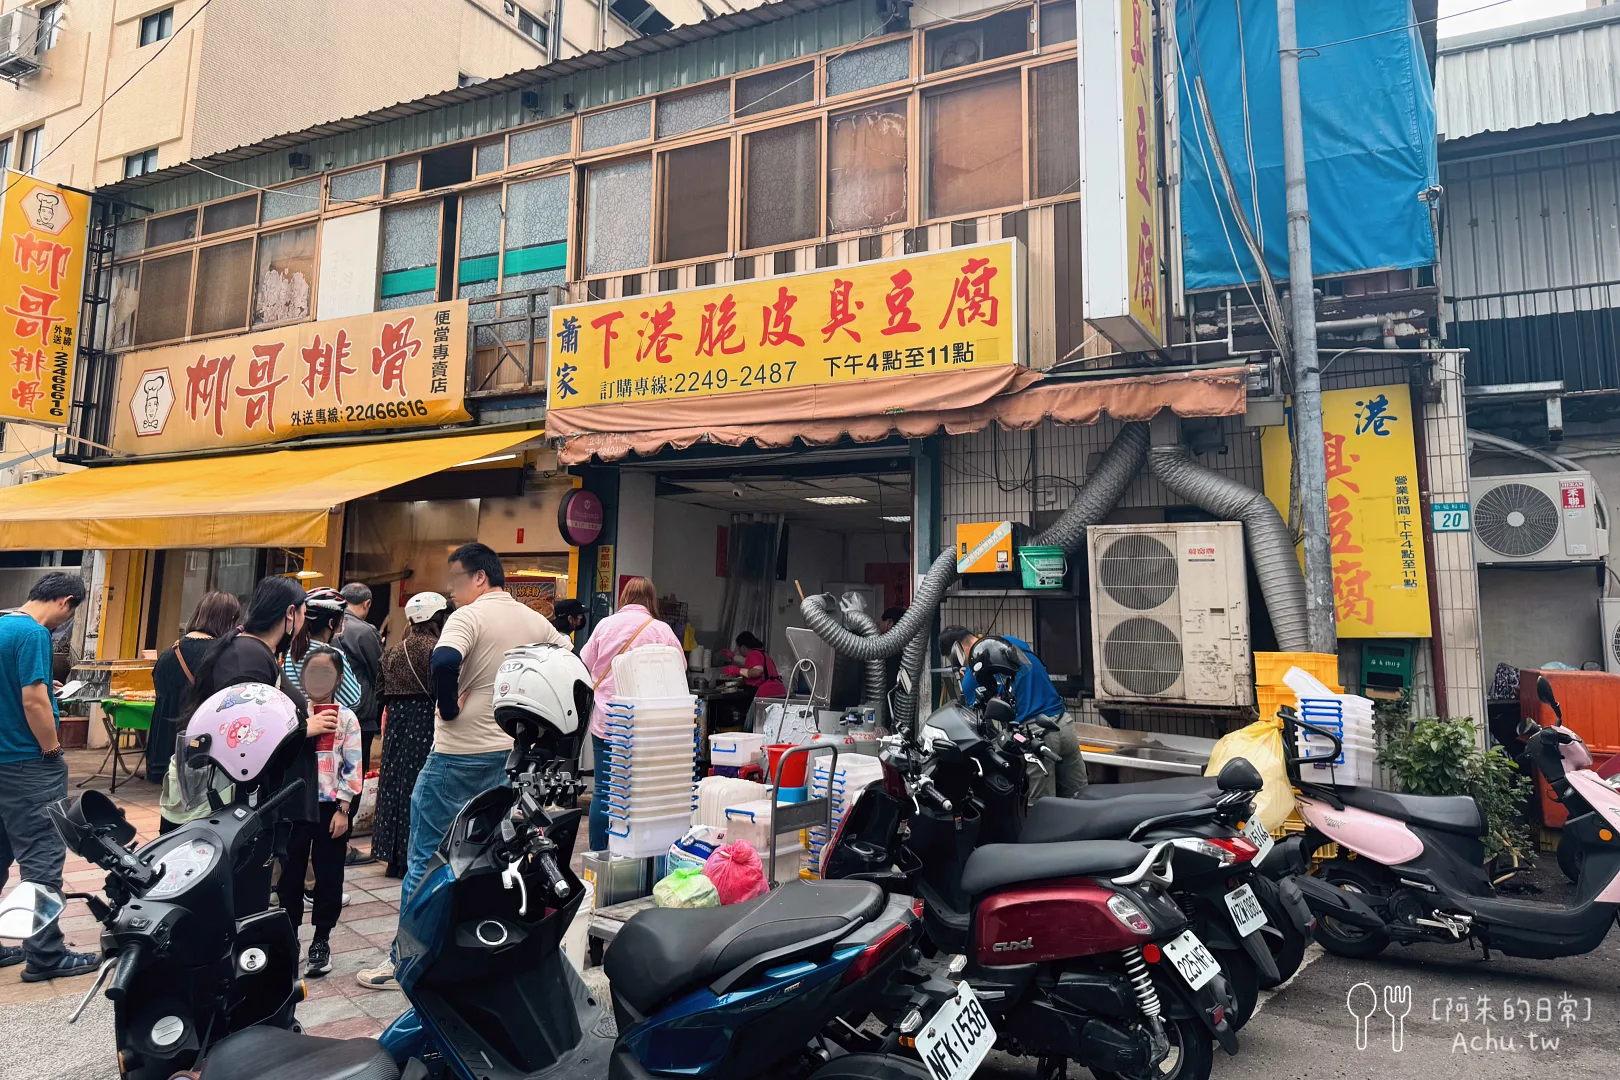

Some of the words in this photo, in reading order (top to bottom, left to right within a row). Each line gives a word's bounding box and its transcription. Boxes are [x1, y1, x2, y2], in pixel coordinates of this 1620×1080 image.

[4, 232, 73, 414] 柳哥排骨
[430, 309, 452, 394] 便當專賣店
[590, 257, 999, 369] 下港脆皮臭豆腐
[185, 316, 423, 437] 柳哥排骨
[556, 316, 582, 400] 蕭家
[823, 341, 975, 377] 下午4點至11點
[1443, 513, 1462, 527] 20
